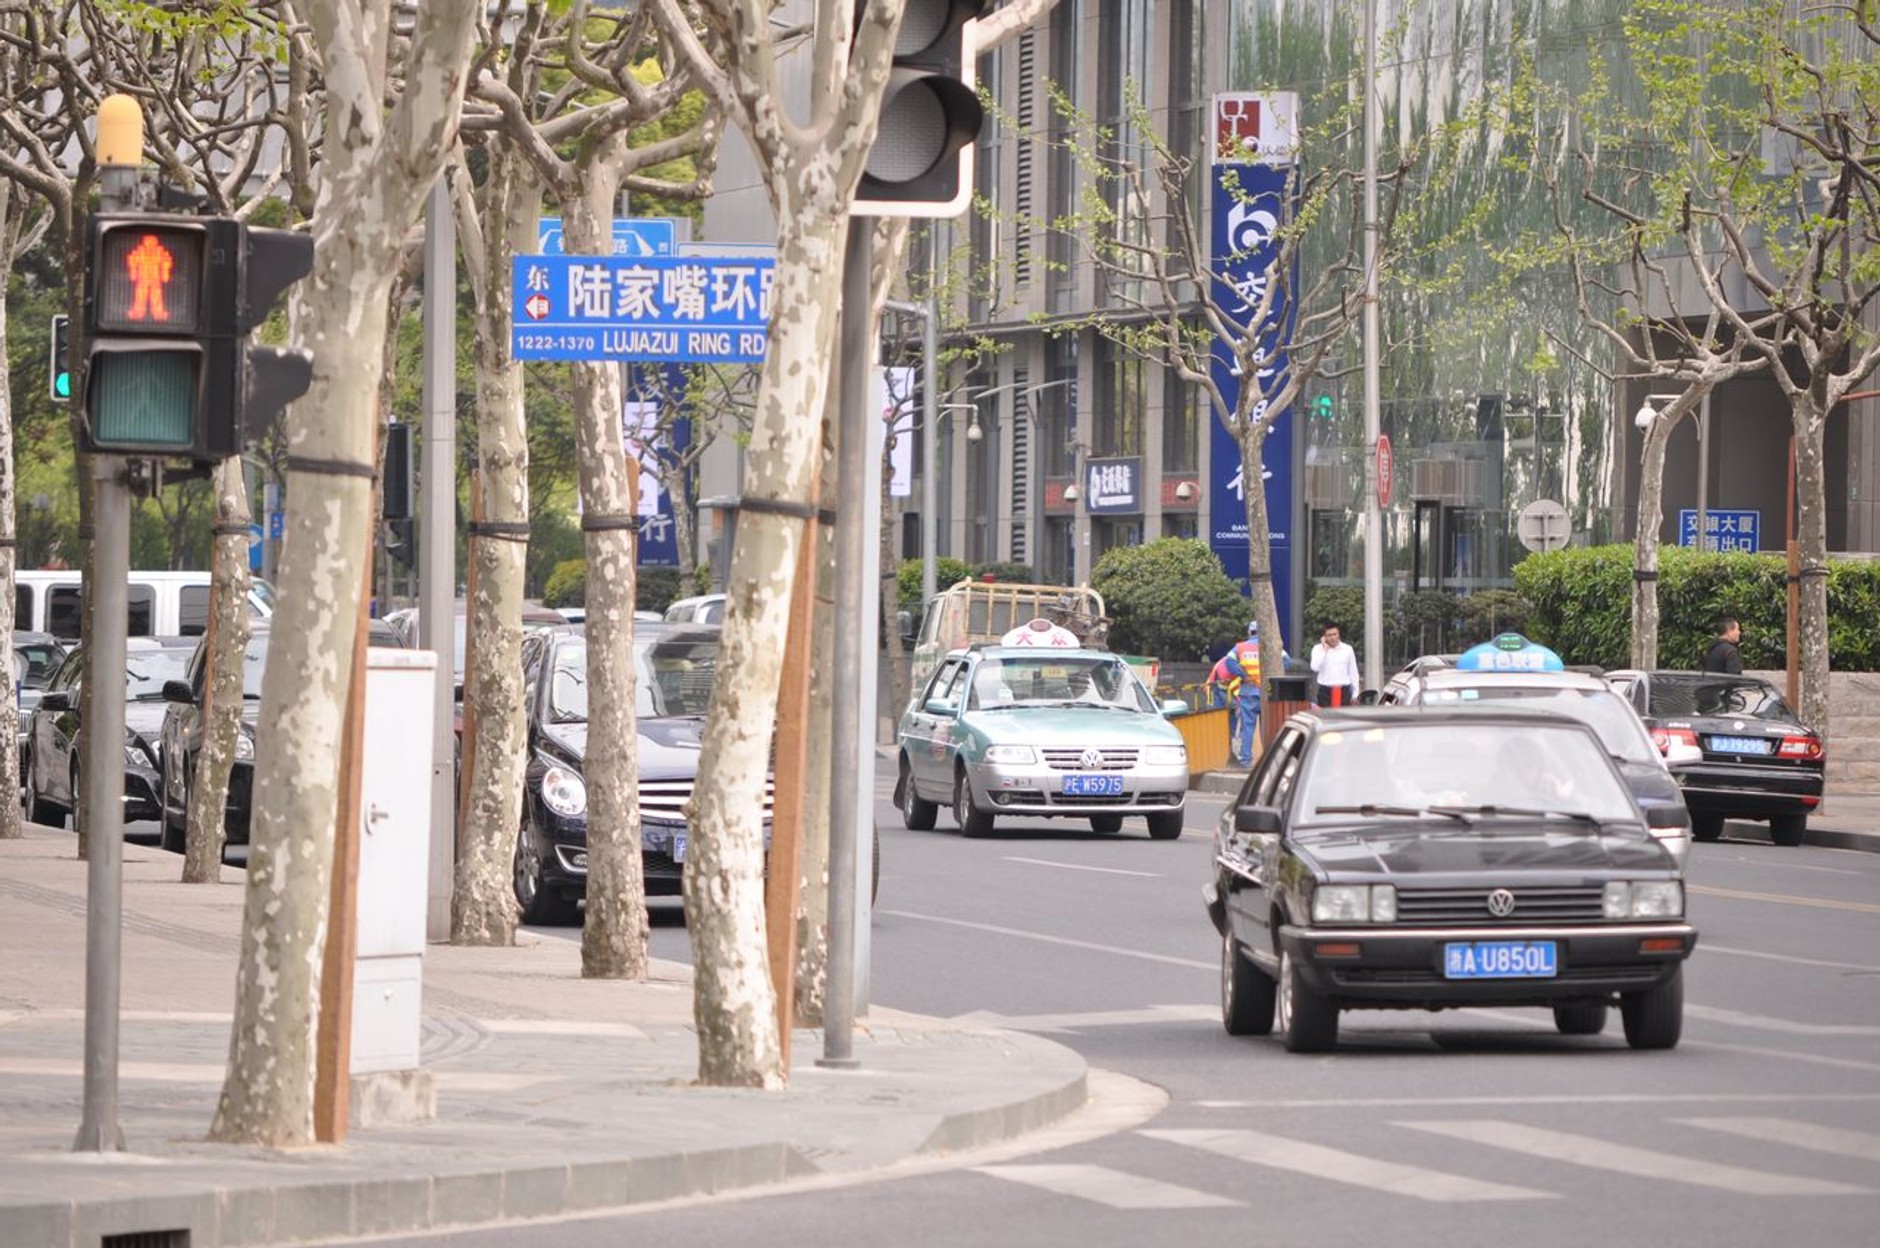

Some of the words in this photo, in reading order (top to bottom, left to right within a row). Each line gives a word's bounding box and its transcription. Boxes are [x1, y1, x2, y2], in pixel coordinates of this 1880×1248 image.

[526, 266, 549, 291] 东
[517, 335, 595, 351] 1222-1370
[603, 330, 679, 354] LUJIAZUI
[688, 333, 730, 355] RING
[740, 333, 765, 355] RD
[1686, 514, 1755, 534] 交银大厦
